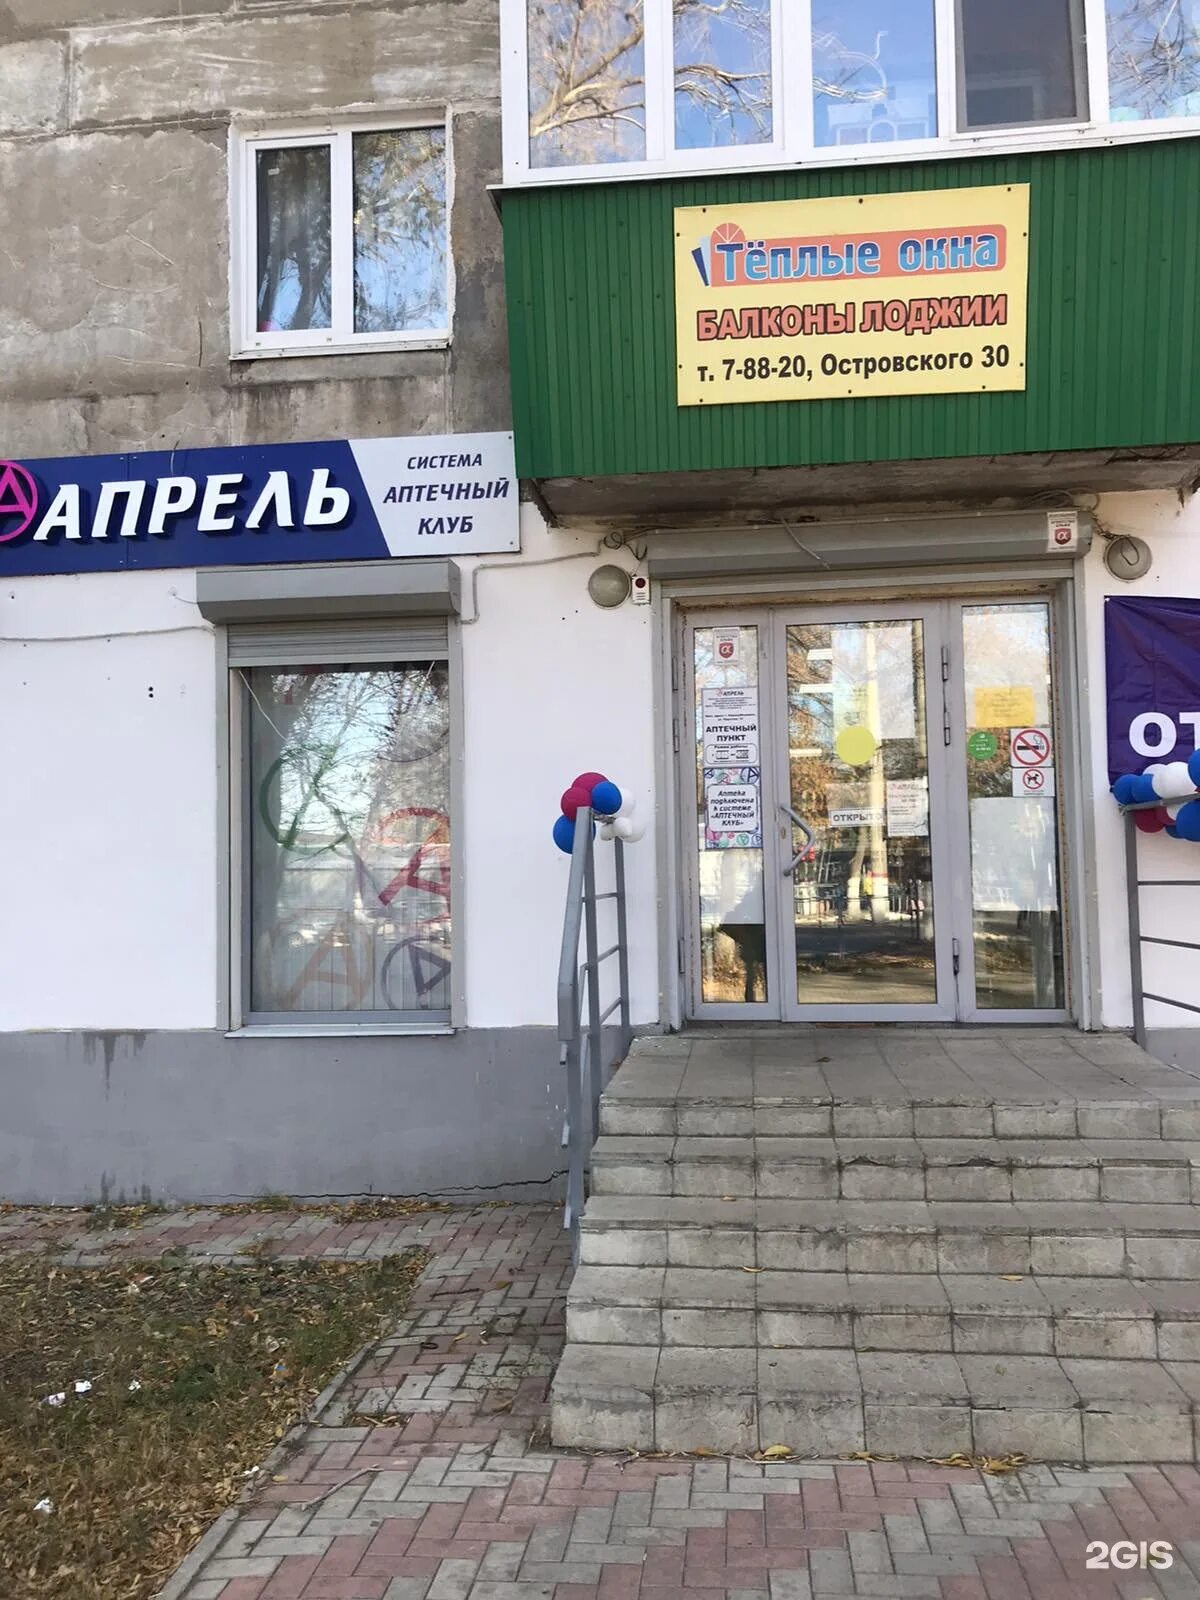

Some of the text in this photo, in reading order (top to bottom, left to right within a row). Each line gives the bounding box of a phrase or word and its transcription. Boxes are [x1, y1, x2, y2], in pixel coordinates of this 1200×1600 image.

[715, 232, 999, 282] Тёплые окна
[697, 294, 1008, 341] БАЛКОНЫ ЛОДЖИИ
[697, 344, 1010, 382] т. 7-88-20, Островского 30
[407, 453, 483, 470] СИСТЕМА
[33, 468, 350, 541] АПРЕЛЬ
[384, 476, 510, 504] АПТЕЧНЫЙ
[417, 515, 474, 535] КЛУБ
[706, 723, 757, 733] АПТЕЧНЫЙ
